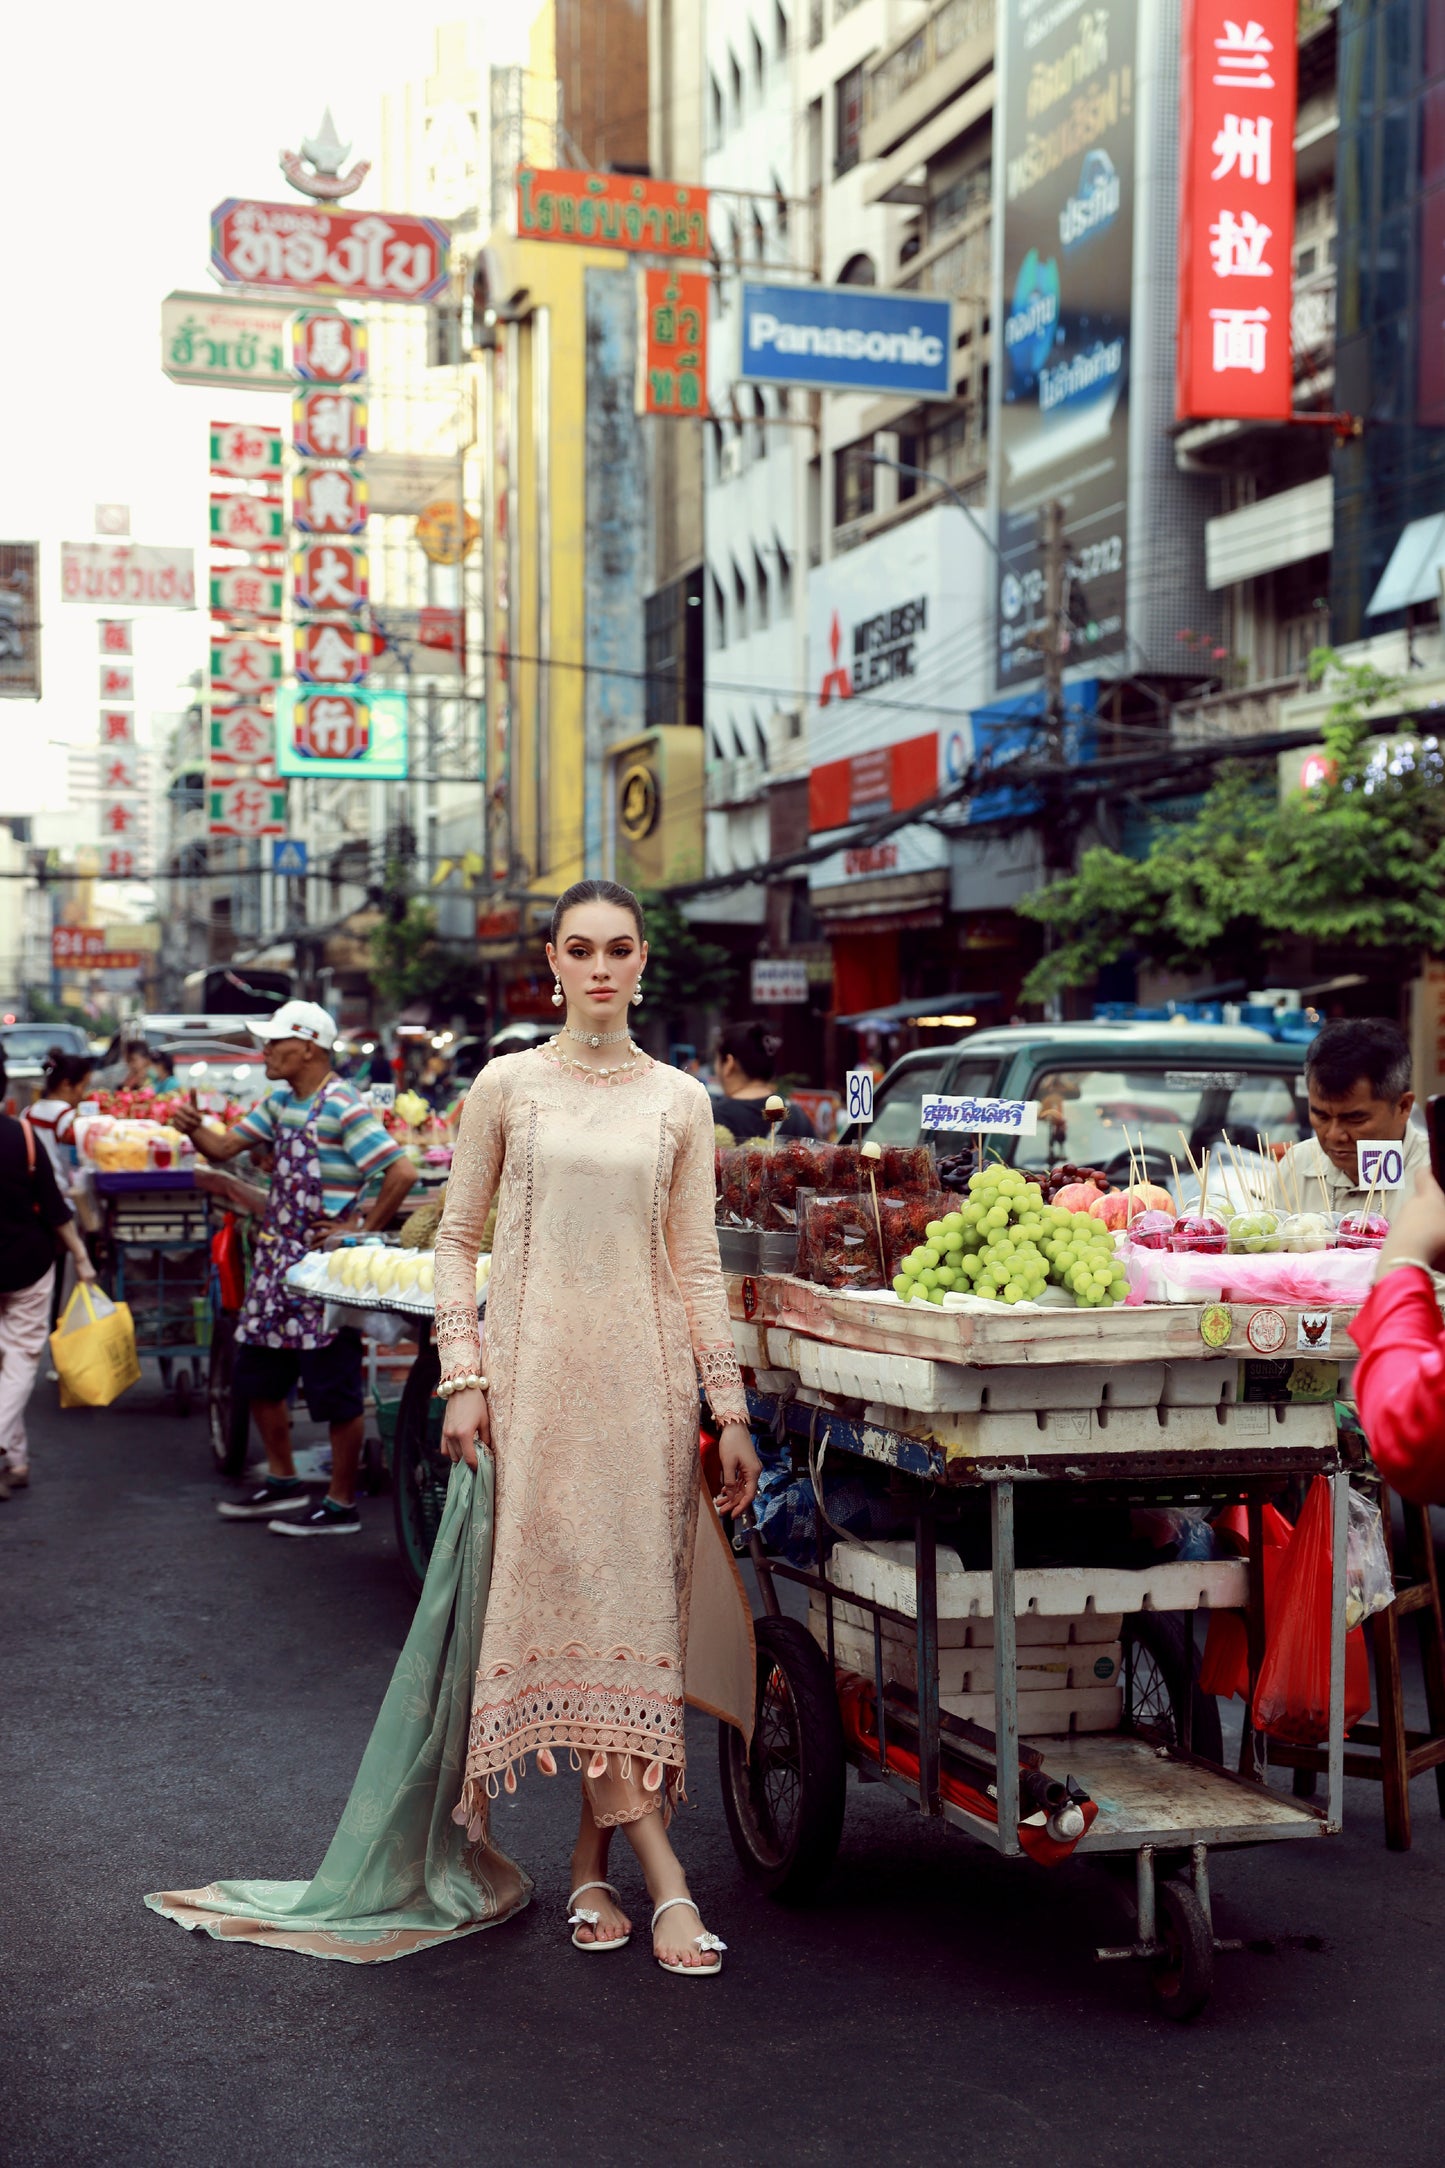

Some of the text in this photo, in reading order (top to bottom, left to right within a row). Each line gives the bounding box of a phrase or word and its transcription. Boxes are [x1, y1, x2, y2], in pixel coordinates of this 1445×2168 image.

[519, 171, 705, 248] โรงรับจำนำ
[1208, 20, 1275, 373] 兰州拉面
[230, 216, 431, 293] ทองใบ
[750, 312, 944, 367] Panasonic
[854, 594, 927, 656] MITSUBISHI
[854, 642, 915, 694] ELECTRIC
[850, 1075, 872, 1119] 80
[1362, 1149, 1402, 1184] 50
